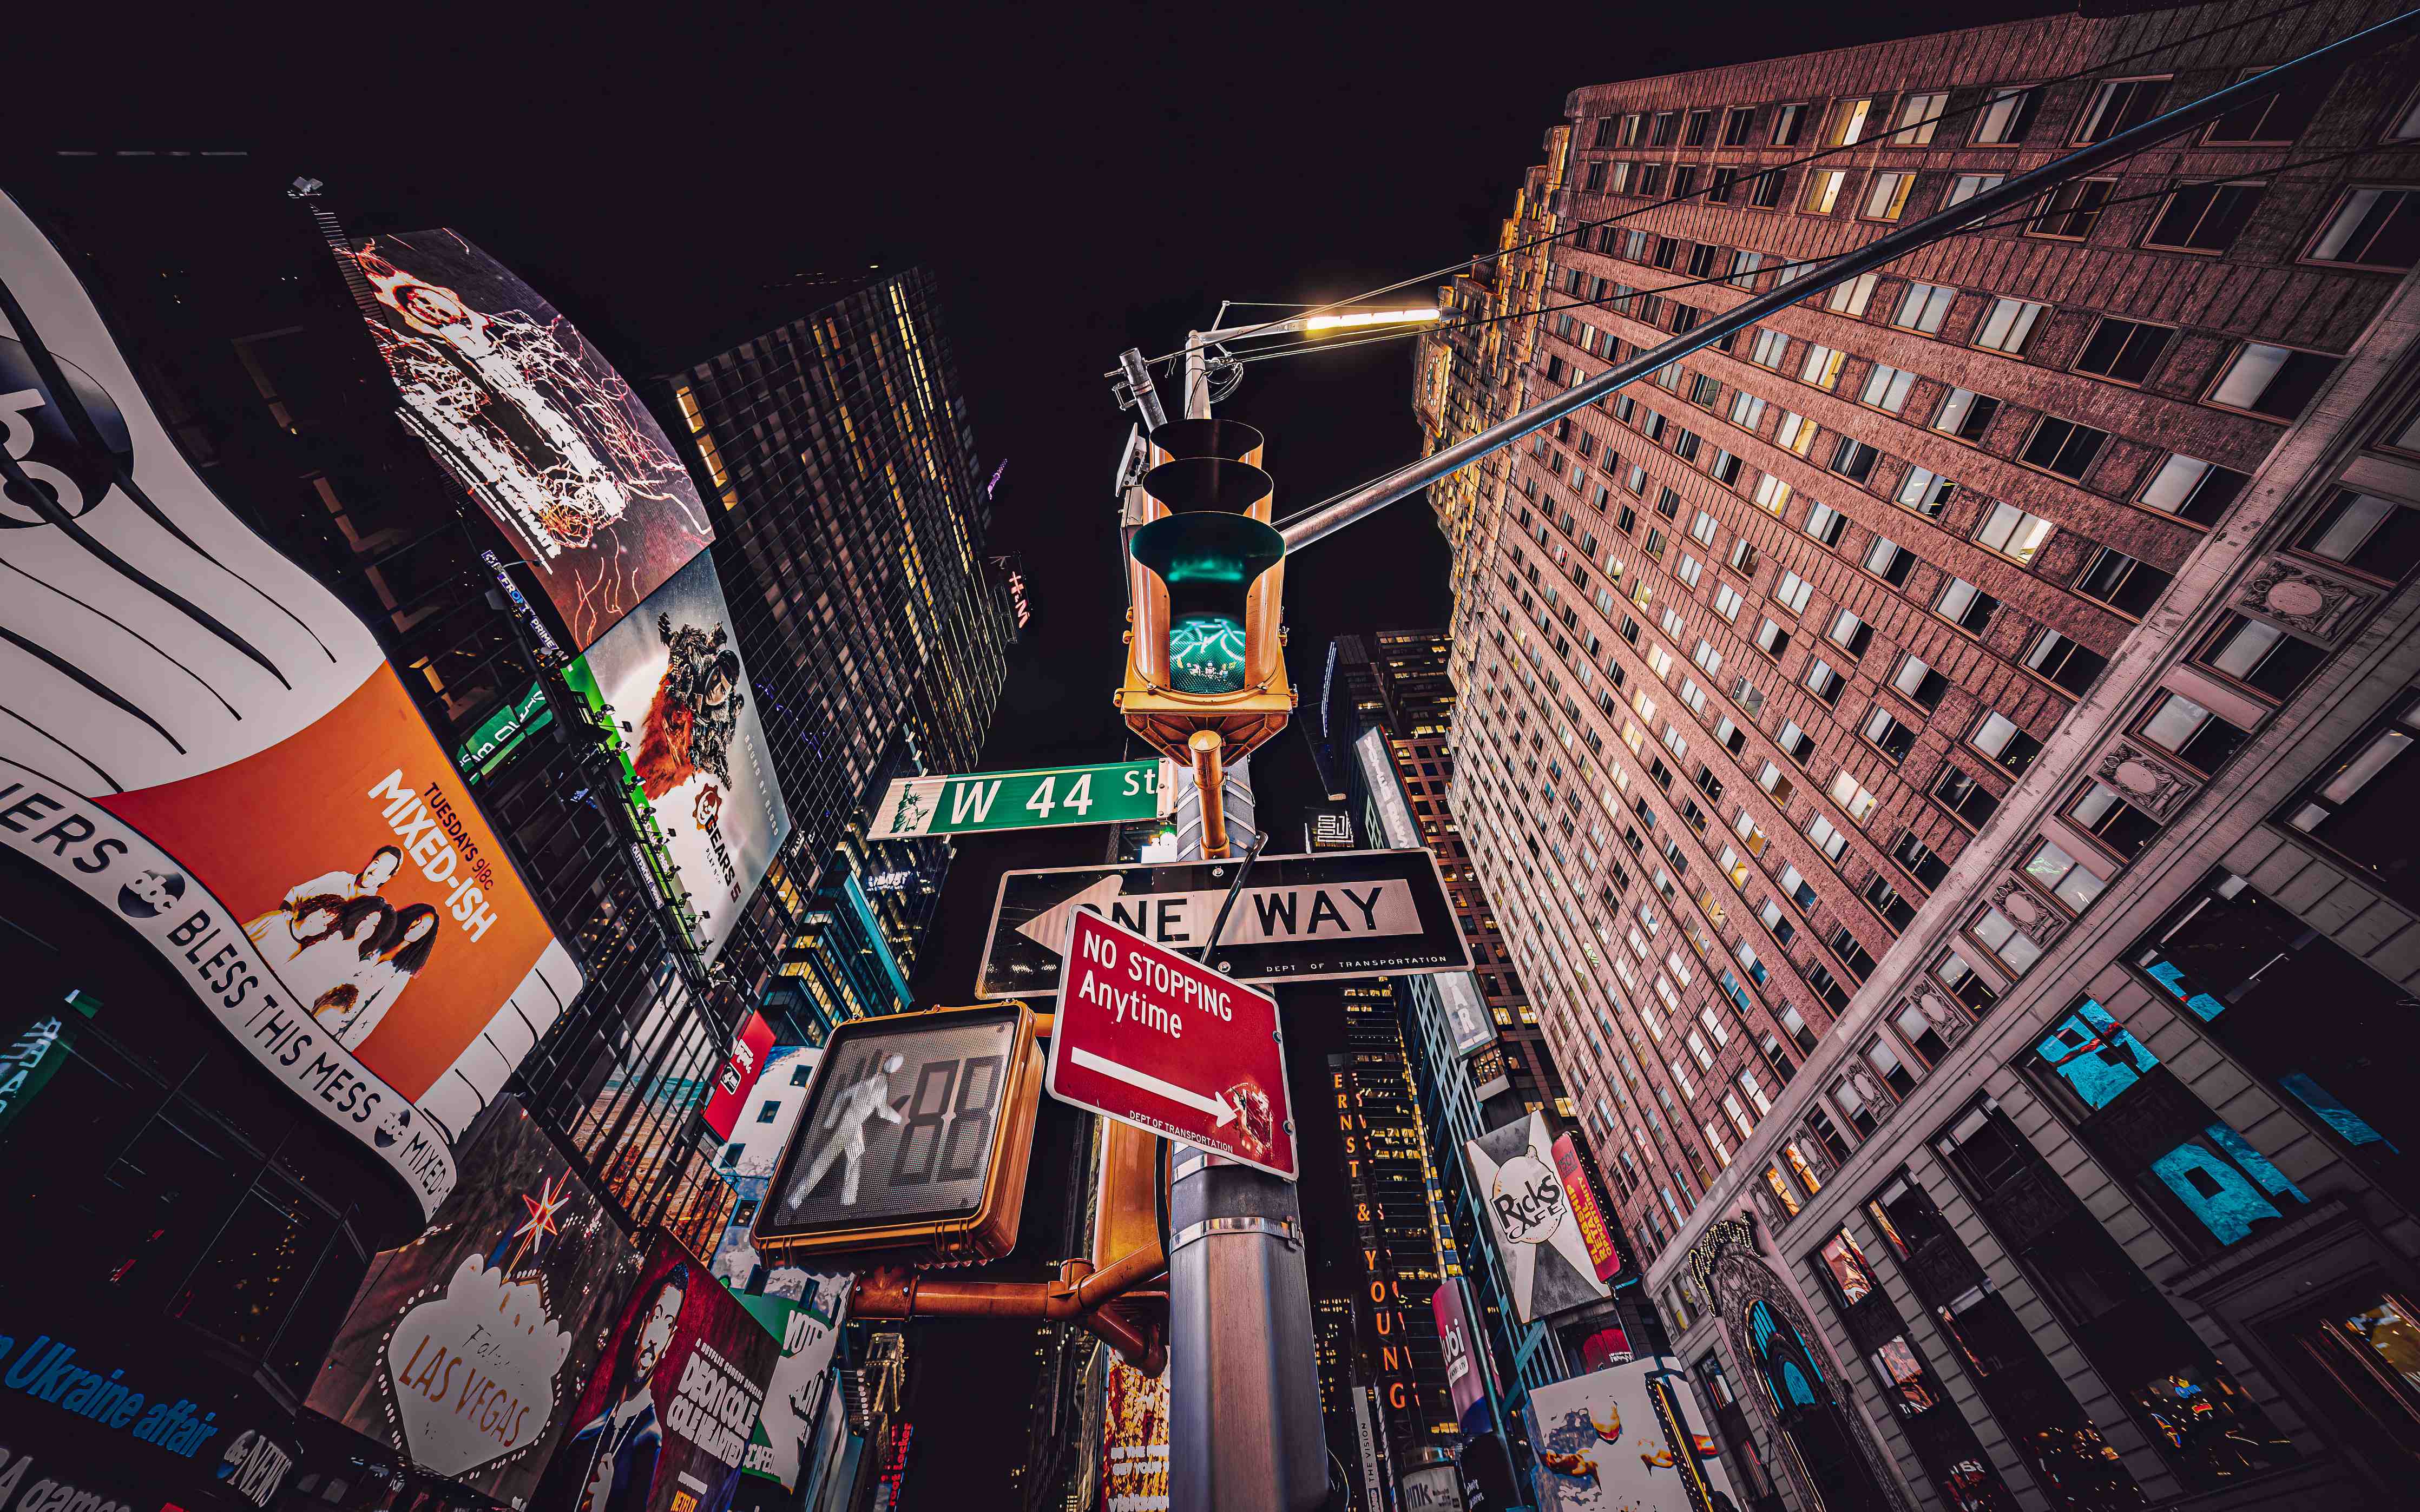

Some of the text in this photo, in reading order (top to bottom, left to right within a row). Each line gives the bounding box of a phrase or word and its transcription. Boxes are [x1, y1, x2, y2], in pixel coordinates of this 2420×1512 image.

[531, 619, 555, 648] PRIME
[745, 734, 779, 836] BOUND BY BLOOD
[950, 768, 1157, 825] W 44 St
[367, 768, 497, 943] MIXED-ISH
[424, 782, 478, 862] TUESDAYS
[705, 813, 742, 903] GEARS 5
[1253, 886, 1383, 937] WAY
[1083, 929, 1233, 1022] NO STOPPING
[1266, 964, 1297, 973] DEPT
[1338, 956, 1448, 968] TRANSPORTATION
[166, 909, 258, 1009] BLESS
[244, 994, 313, 1067] THIS
[298, 1051, 382, 1123] MESS
[1078, 969, 1183, 1040] Anytime
[1129, 1110, 1234, 1153] DEPT OF TRANSPORTATION
[1333, 1073, 1360, 1178] ERNST
[1357, 1202, 1371, 1222] &
[1364, 1250, 1406, 1409] YOUNG
[1566, 1184, 1601, 1265] FLAGSHIP
[1577, 1176, 1612, 1257] OPPORTUNITY
[1582, 1202, 1607, 1262] RETAIL
[4, 1335, 219, 1458] Ukraine affair
[398, 1333, 463, 1404] LAS
[678, 1351, 727, 1417] DEON
[721, 1385, 760, 1440] COLE
[695, 1338, 702, 1348] A
[701, 1342, 725, 1368] NETFLIX
[724, 1362, 745, 1384] COMEDY
[226, 1435, 293, 1508] NEWS
[1361, 1423, 1371, 1458] VISION
[1366, 1462, 1375, 1483] THE
[670, 1490, 699, 1512] NETFLIX
